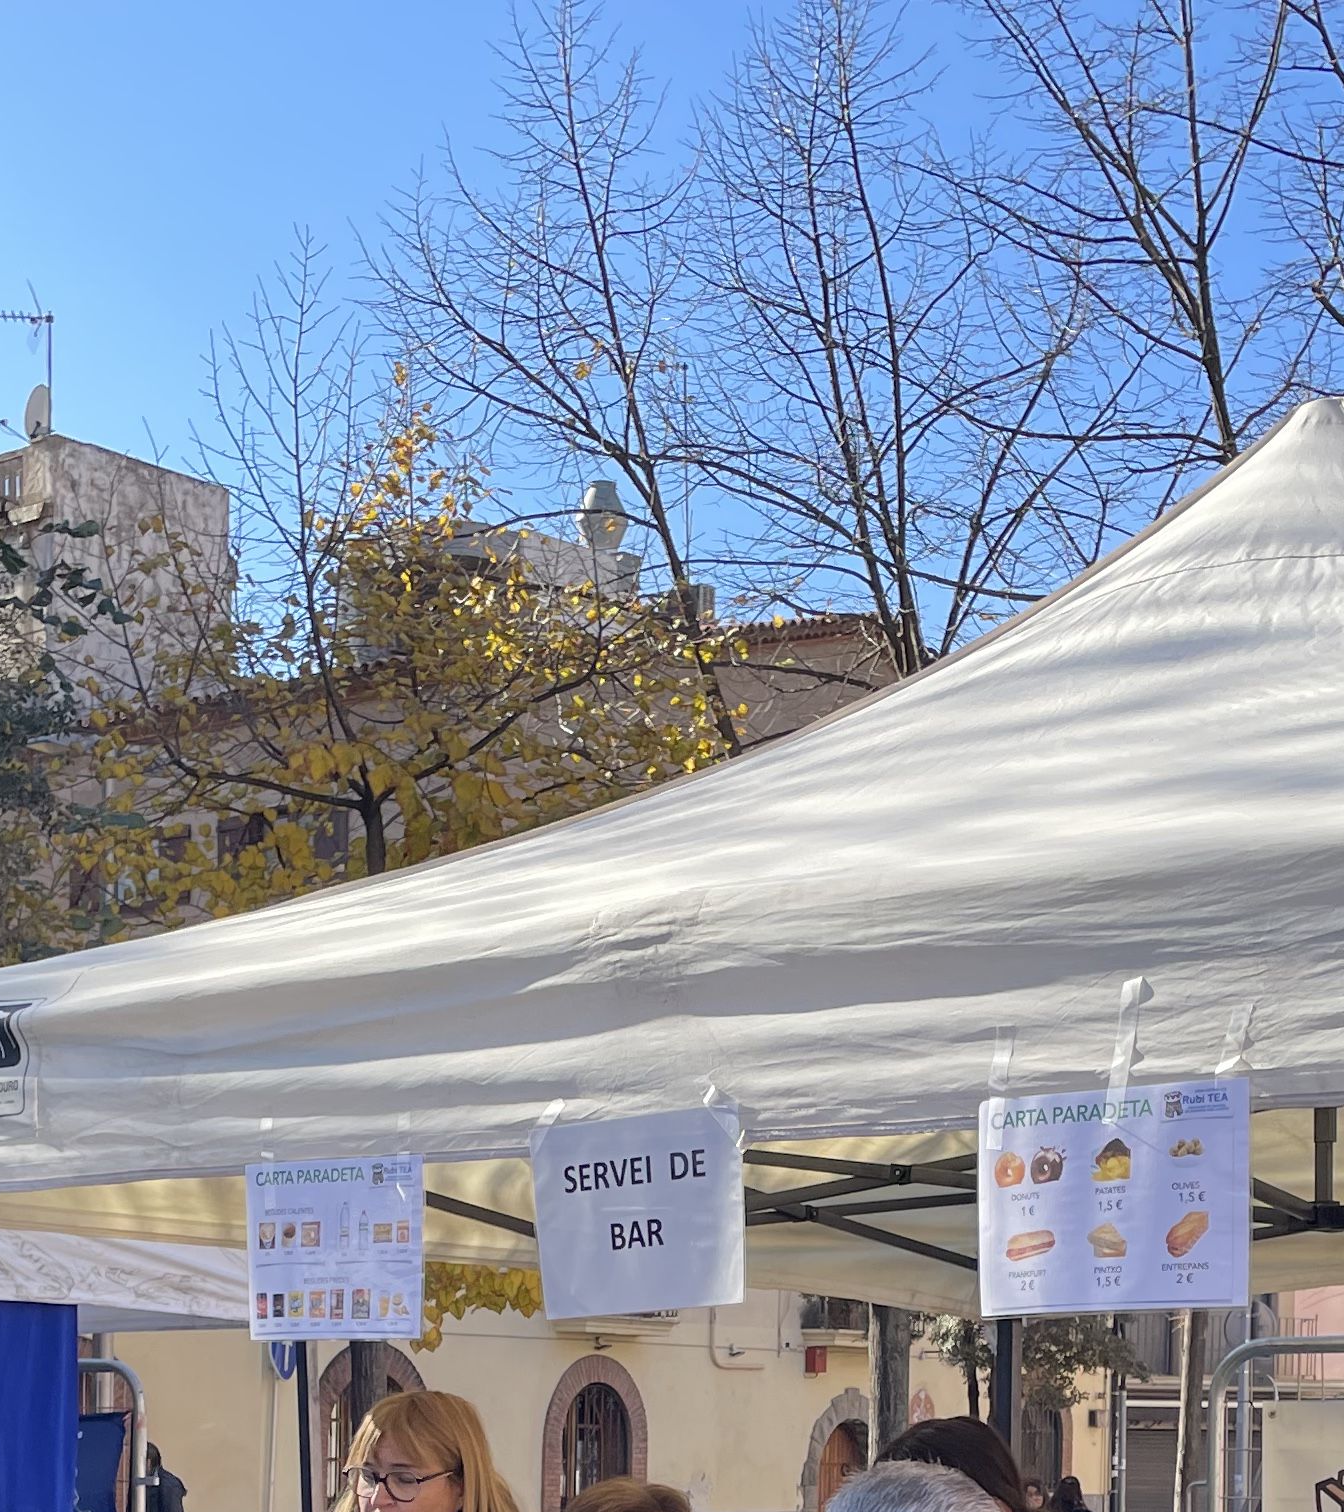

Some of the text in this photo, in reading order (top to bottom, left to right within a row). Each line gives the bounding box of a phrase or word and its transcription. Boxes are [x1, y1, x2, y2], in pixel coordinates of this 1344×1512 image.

[1206, 1092, 1229, 1104] TEA
[990, 1098, 1154, 1132] CARTA PARADETA
[256, 1166, 365, 1187] CARTA PARADETA
[564, 1149, 707, 1194] SERVEI DE
[1095, 1186, 1126, 1195] PATATES
[1172, 1182, 1200, 1191] OLIVES
[1178, 1191, 1206, 1203] 1,5 €
[1098, 1200, 1123, 1213] 1,5 €
[610, 1218, 665, 1251] BAR
[1094, 1265, 1122, 1275] PINTXO
[1161, 1262, 1209, 1271] ENTREPANS
[1008, 1269, 1047, 1280] FRANKFURT
[1176, 1273, 1194, 1283] 2 €
[1020, 1280, 1027, 1291] 2
[1096, 1275, 1121, 1288] 1,5 €
